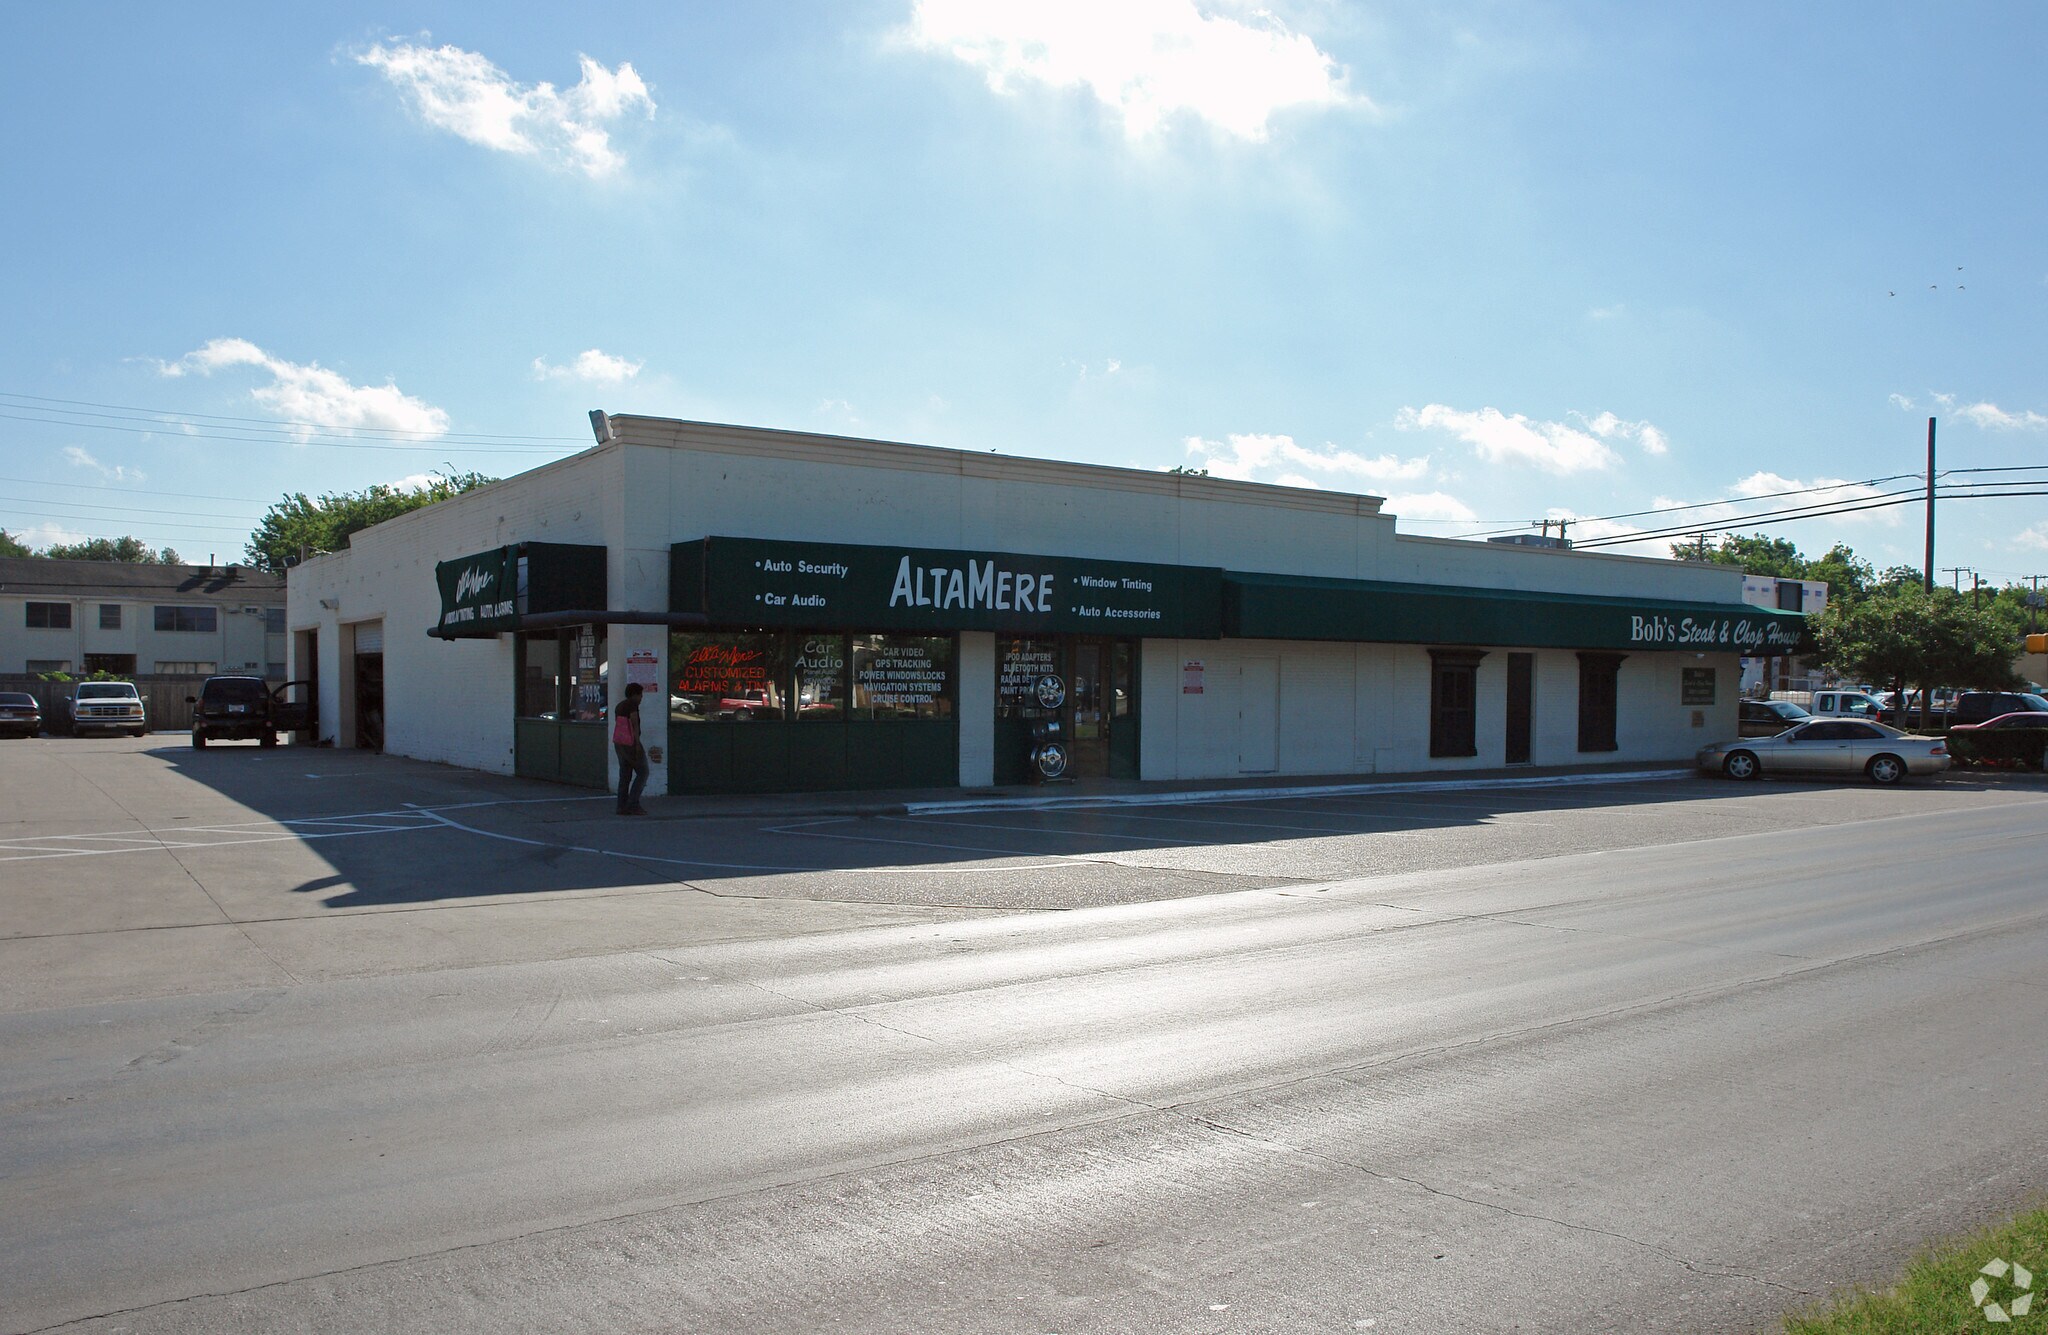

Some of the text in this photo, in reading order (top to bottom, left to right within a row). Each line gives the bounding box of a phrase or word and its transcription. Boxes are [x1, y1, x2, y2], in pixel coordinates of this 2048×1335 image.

[764, 559, 848, 578] Auto Security
[1080, 575, 1152, 592] Window Tinting
[764, 592, 826, 606] Car Audio
[480, 604, 493, 619] AUTO
[1079, 605, 1161, 619] Auto Accessories
[1630, 615, 1802, 648] Bob's Steak & Chop House
[804, 640, 835, 654] Car
[883, 647, 924, 657] CAR VIDEO
[794, 655, 844, 669] Audio
[1021, 652, 1052, 661] ADAPTERS
[875, 659, 932, 669] GPS TRACKING
[1040, 664, 1054, 673] KITS
[685, 666, 767, 680] CUSTOMIZED
[859, 671, 886, 681] POWER
[1000, 675, 1022, 684] RADAR
[678, 680, 729, 693] ALARMS
[863, 682, 942, 692] NAVIGATION SYSTEMS
[1000, 686, 1018, 695] PAINT
[871, 694, 934, 704] CRUISE CONTROL
